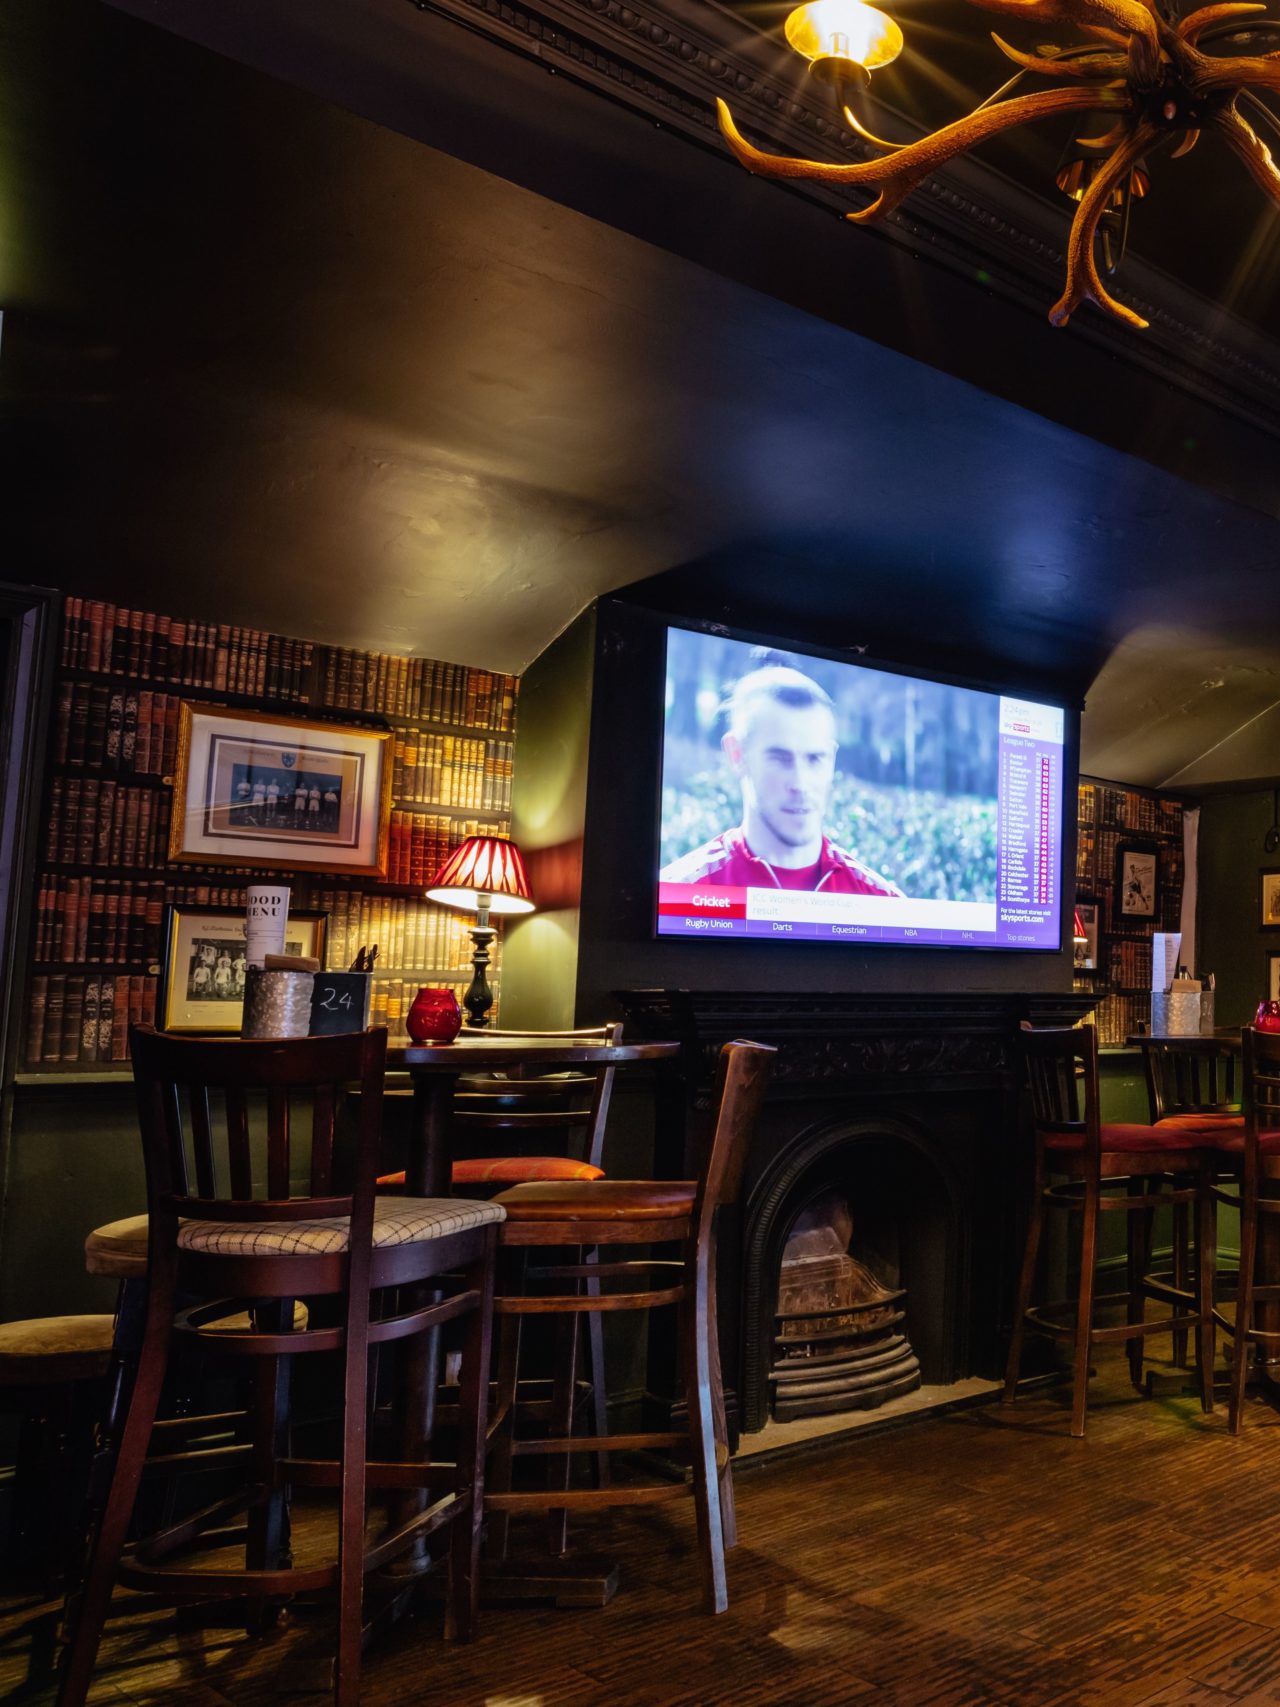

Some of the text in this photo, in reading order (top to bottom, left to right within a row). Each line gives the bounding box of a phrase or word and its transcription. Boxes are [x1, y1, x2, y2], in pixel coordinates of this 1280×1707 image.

[1003, 736, 1036, 748] League Two
[248, 896, 281, 904] OOD
[692, 895, 730, 908] Cricket
[810, 896, 834, 906] World
[753, 905, 778, 915] result
[686, 918, 733, 929] Rugby Union
[1001, 914, 1044, 923] skysports.com
[772, 923, 792, 932] Darts
[832, 926, 866, 936] Equestrian
[320, 987, 352, 1010] 24
